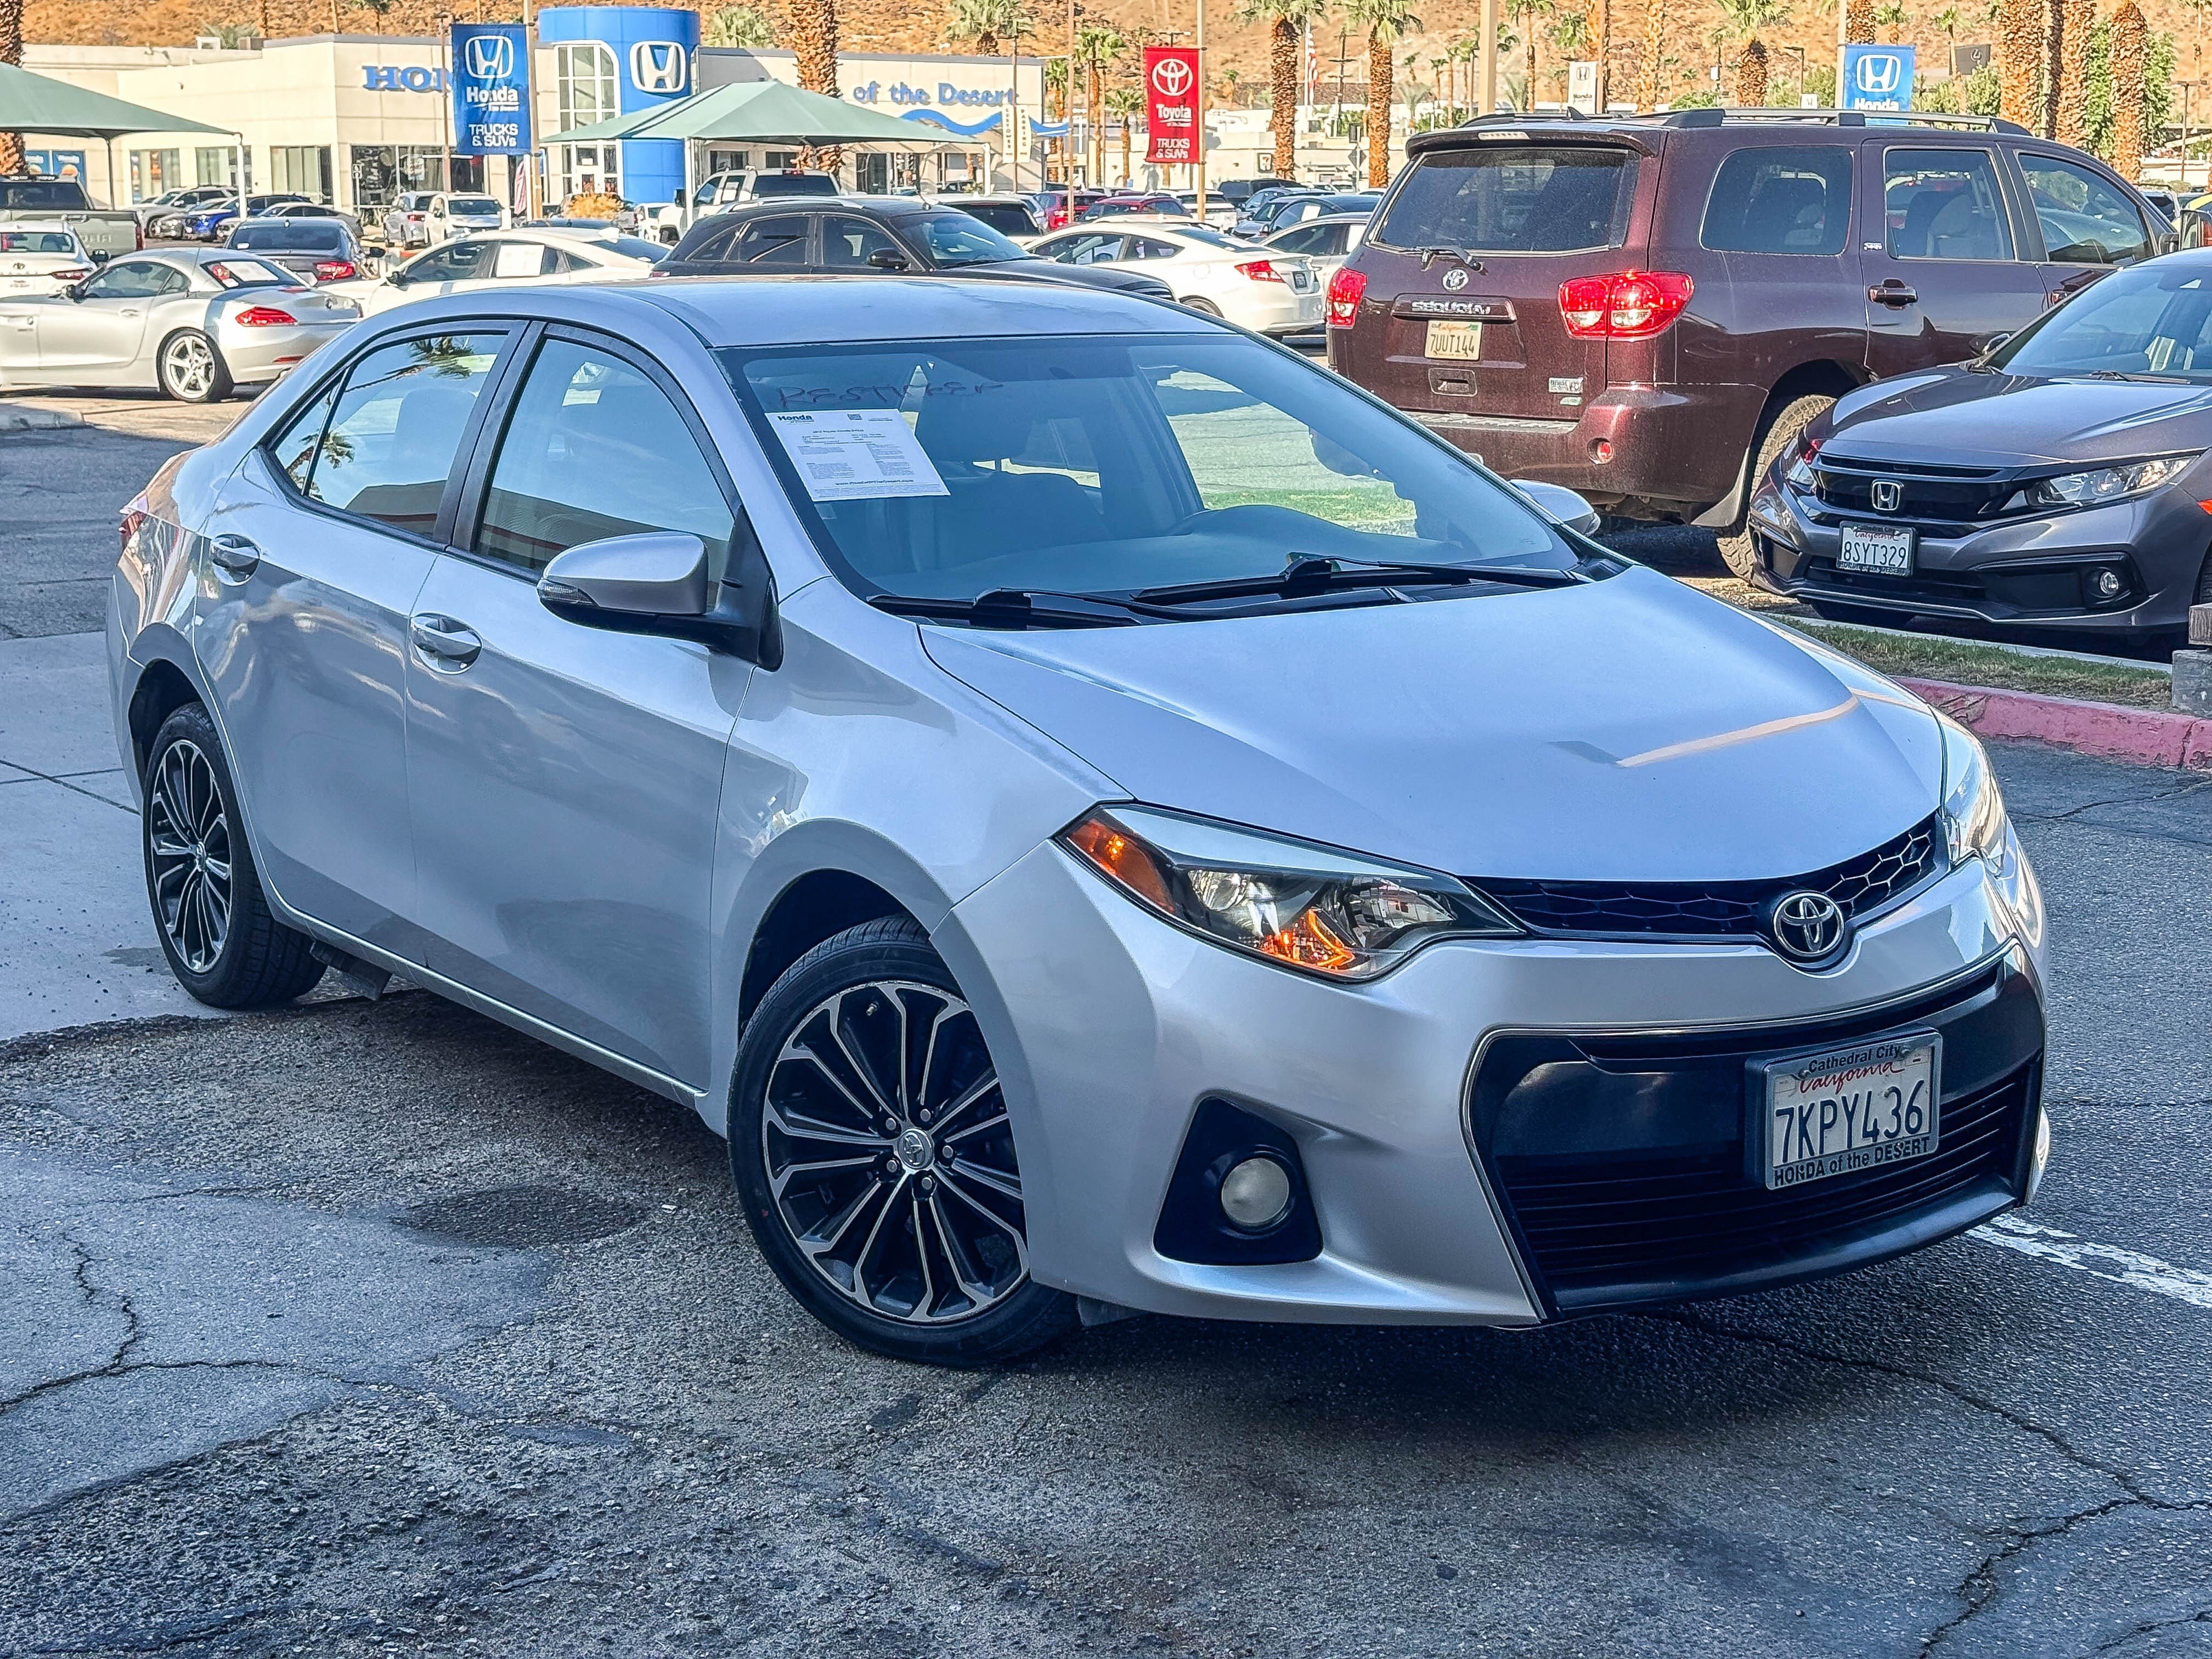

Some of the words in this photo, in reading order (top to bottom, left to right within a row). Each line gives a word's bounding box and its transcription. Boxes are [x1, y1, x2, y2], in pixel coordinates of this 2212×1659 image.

[466, 86, 518, 103] Honda
[854, 81, 880, 104] of
[889, 82, 930, 105] the
[938, 83, 1019, 106] Desert
[1155, 104, 1192, 121] Toyota
[1854, 97, 1899, 111] Honda
[469, 123, 518, 136] TRUCKS
[472, 136, 482, 146] &
[484, 135, 517, 147] SUVs
[1156, 138, 1190, 149] TRUCKS
[1155, 149, 1164, 159] &
[1430, 334, 1474, 354] 7UUT144
[1843, 540, 1906, 567] 8SYT329
[1808, 1048, 1872, 1074] Cathedral
[1876, 1045, 1901, 1059] City
[1799, 1061, 1906, 1095] California
[1775, 1080, 1925, 1163] 7KPY436
[1774, 1159, 1825, 1188] HONDA
[1829, 1153, 1843, 1175] of
[1847, 1148, 1870, 1170] the
[1874, 1136, 1930, 1164] DESERT
